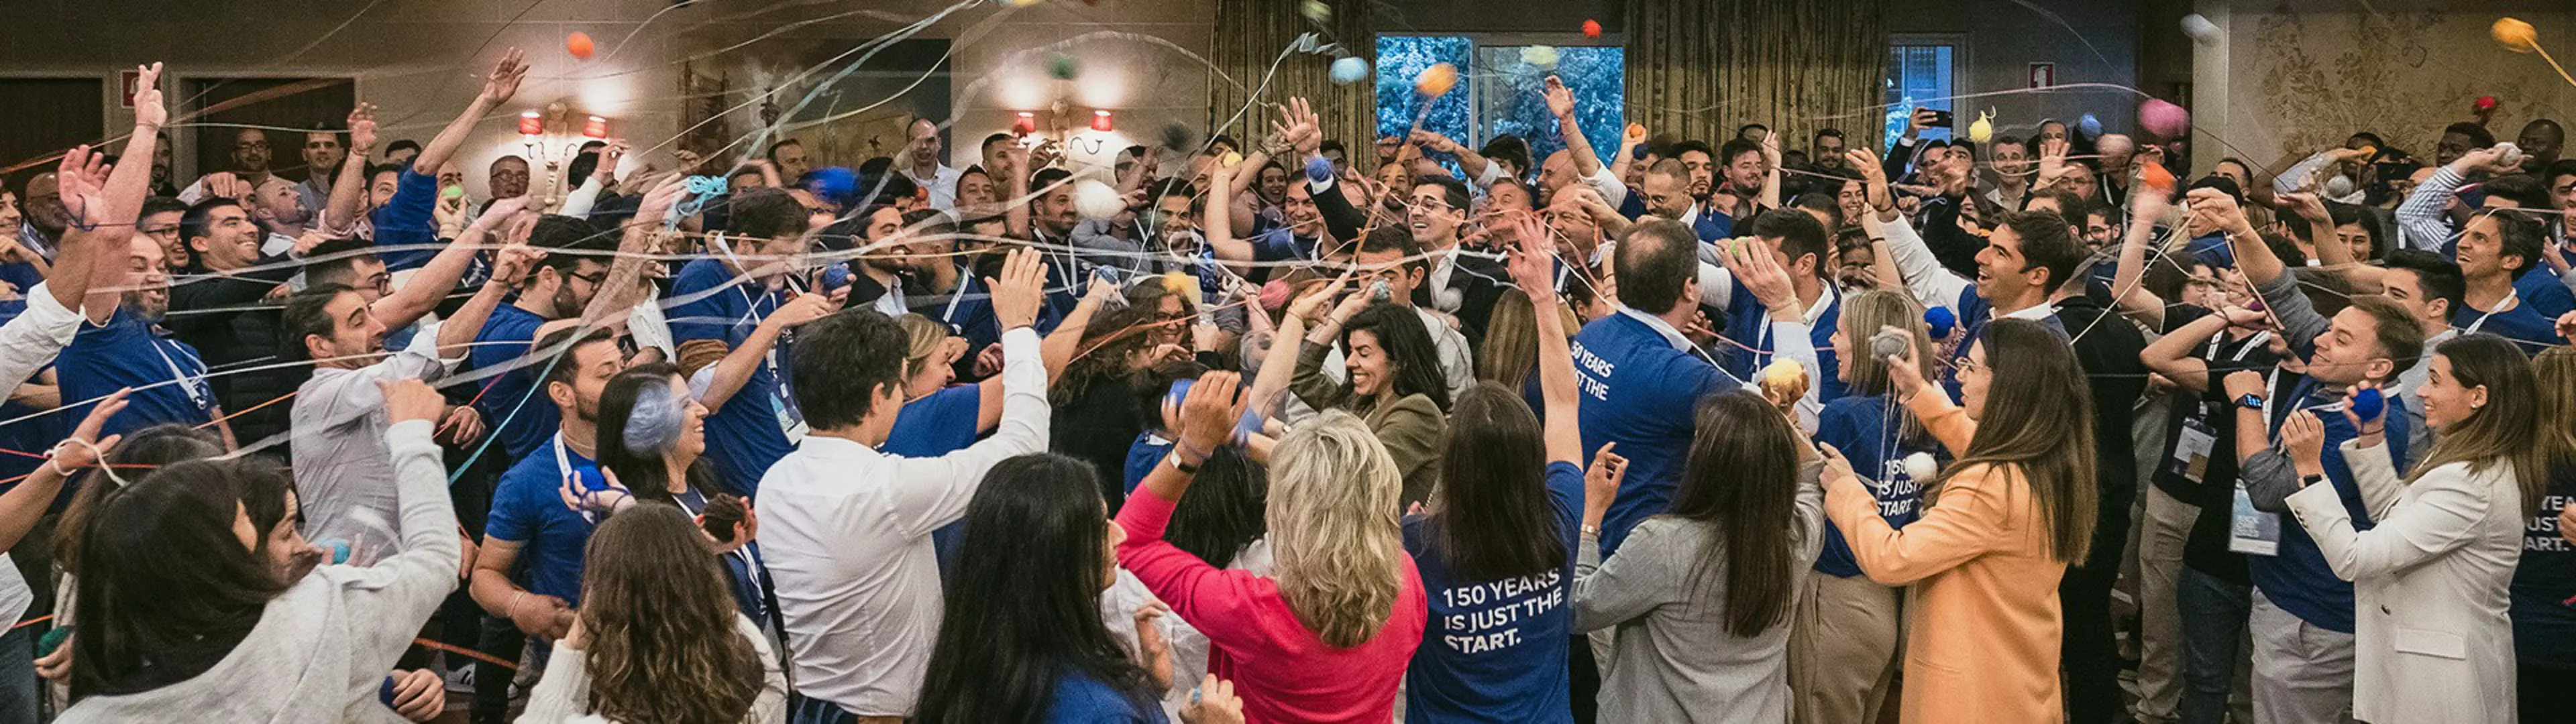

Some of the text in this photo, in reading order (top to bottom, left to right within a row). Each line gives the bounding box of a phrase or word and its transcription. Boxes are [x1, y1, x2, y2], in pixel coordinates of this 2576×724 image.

[1570, 340, 1615, 377] 50 YEARS
[1585, 377, 1609, 401] THE
[2524, 536, 2570, 551] ART.
[1443, 568, 1560, 608] 150 YEARS
[1444, 586, 1562, 634] IS JUST THE
[1444, 627, 1521, 654] START.
